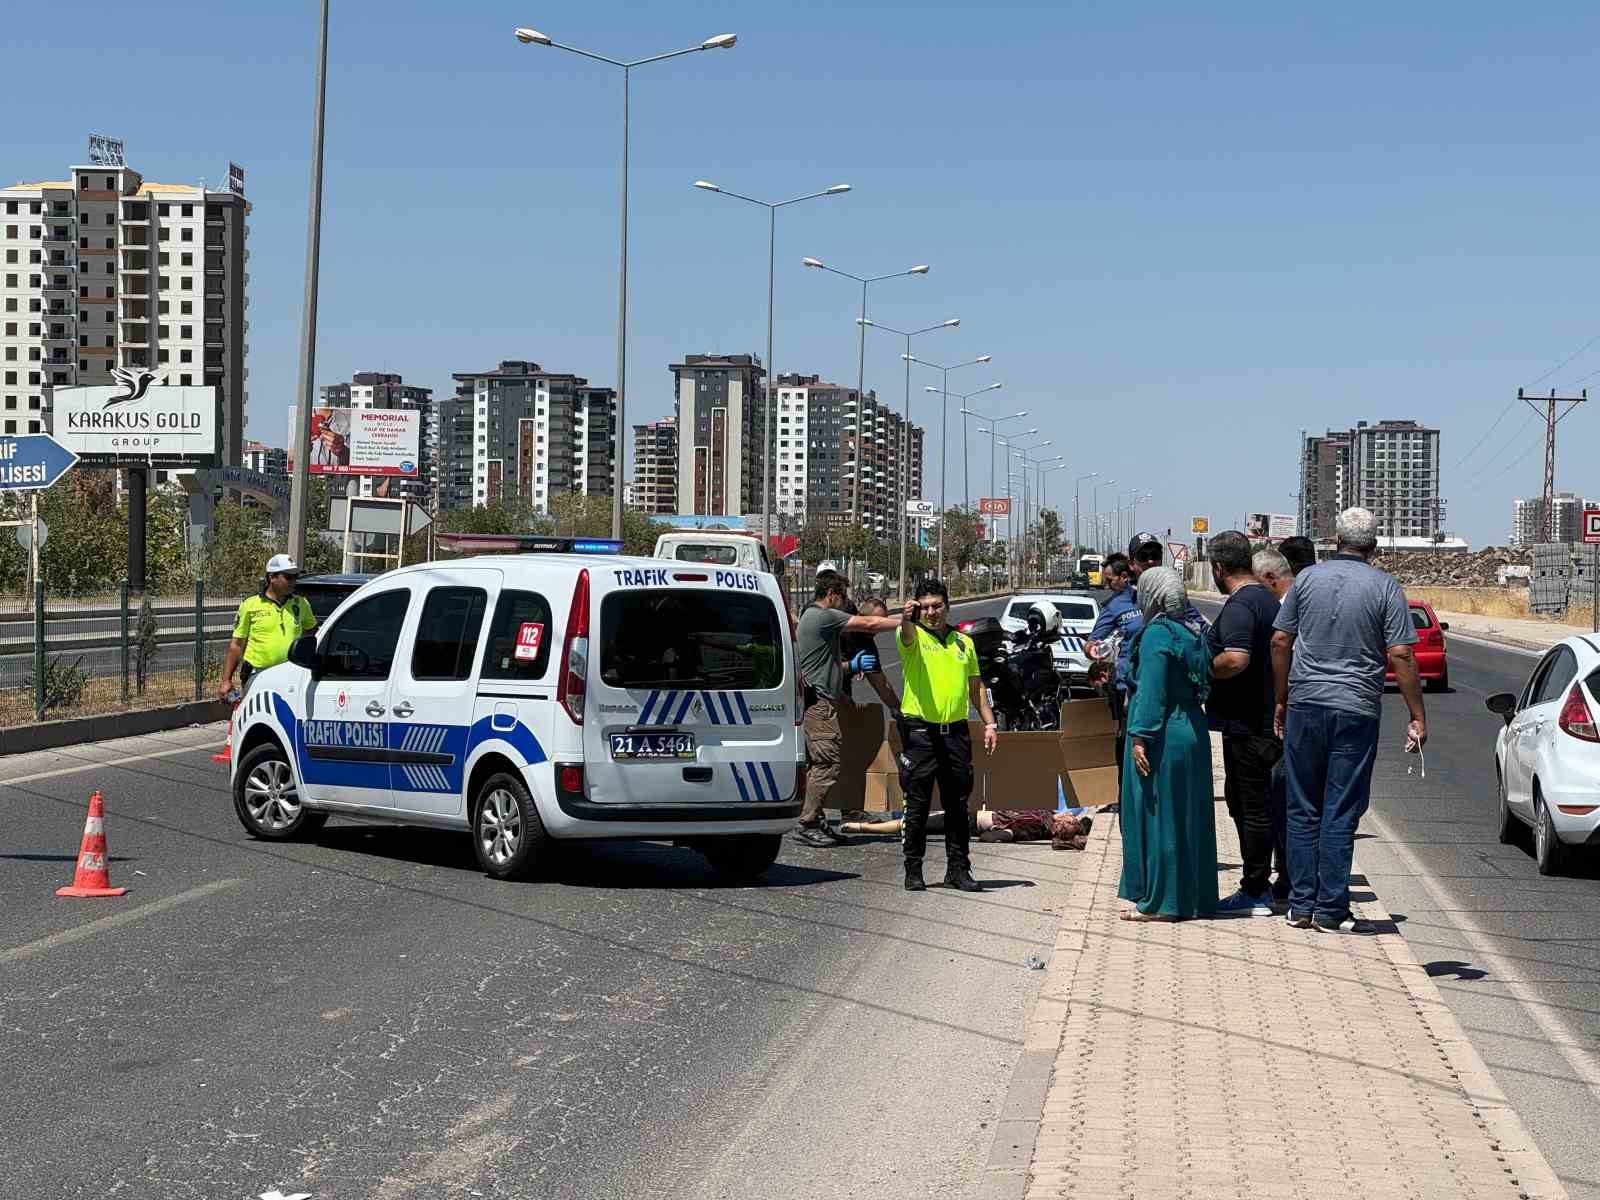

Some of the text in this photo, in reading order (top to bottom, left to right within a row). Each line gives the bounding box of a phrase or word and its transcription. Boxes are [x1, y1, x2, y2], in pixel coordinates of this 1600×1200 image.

[157, 412, 201, 429] GOLD
[361, 414, 408, 422] MEMORIAL
[111, 438, 160, 446] GROUP
[0, 461, 47, 483] LİSESİ
[916, 503, 932, 511] Car
[521, 626, 539, 645] 112
[615, 736, 692, 753] 21 A 5461
